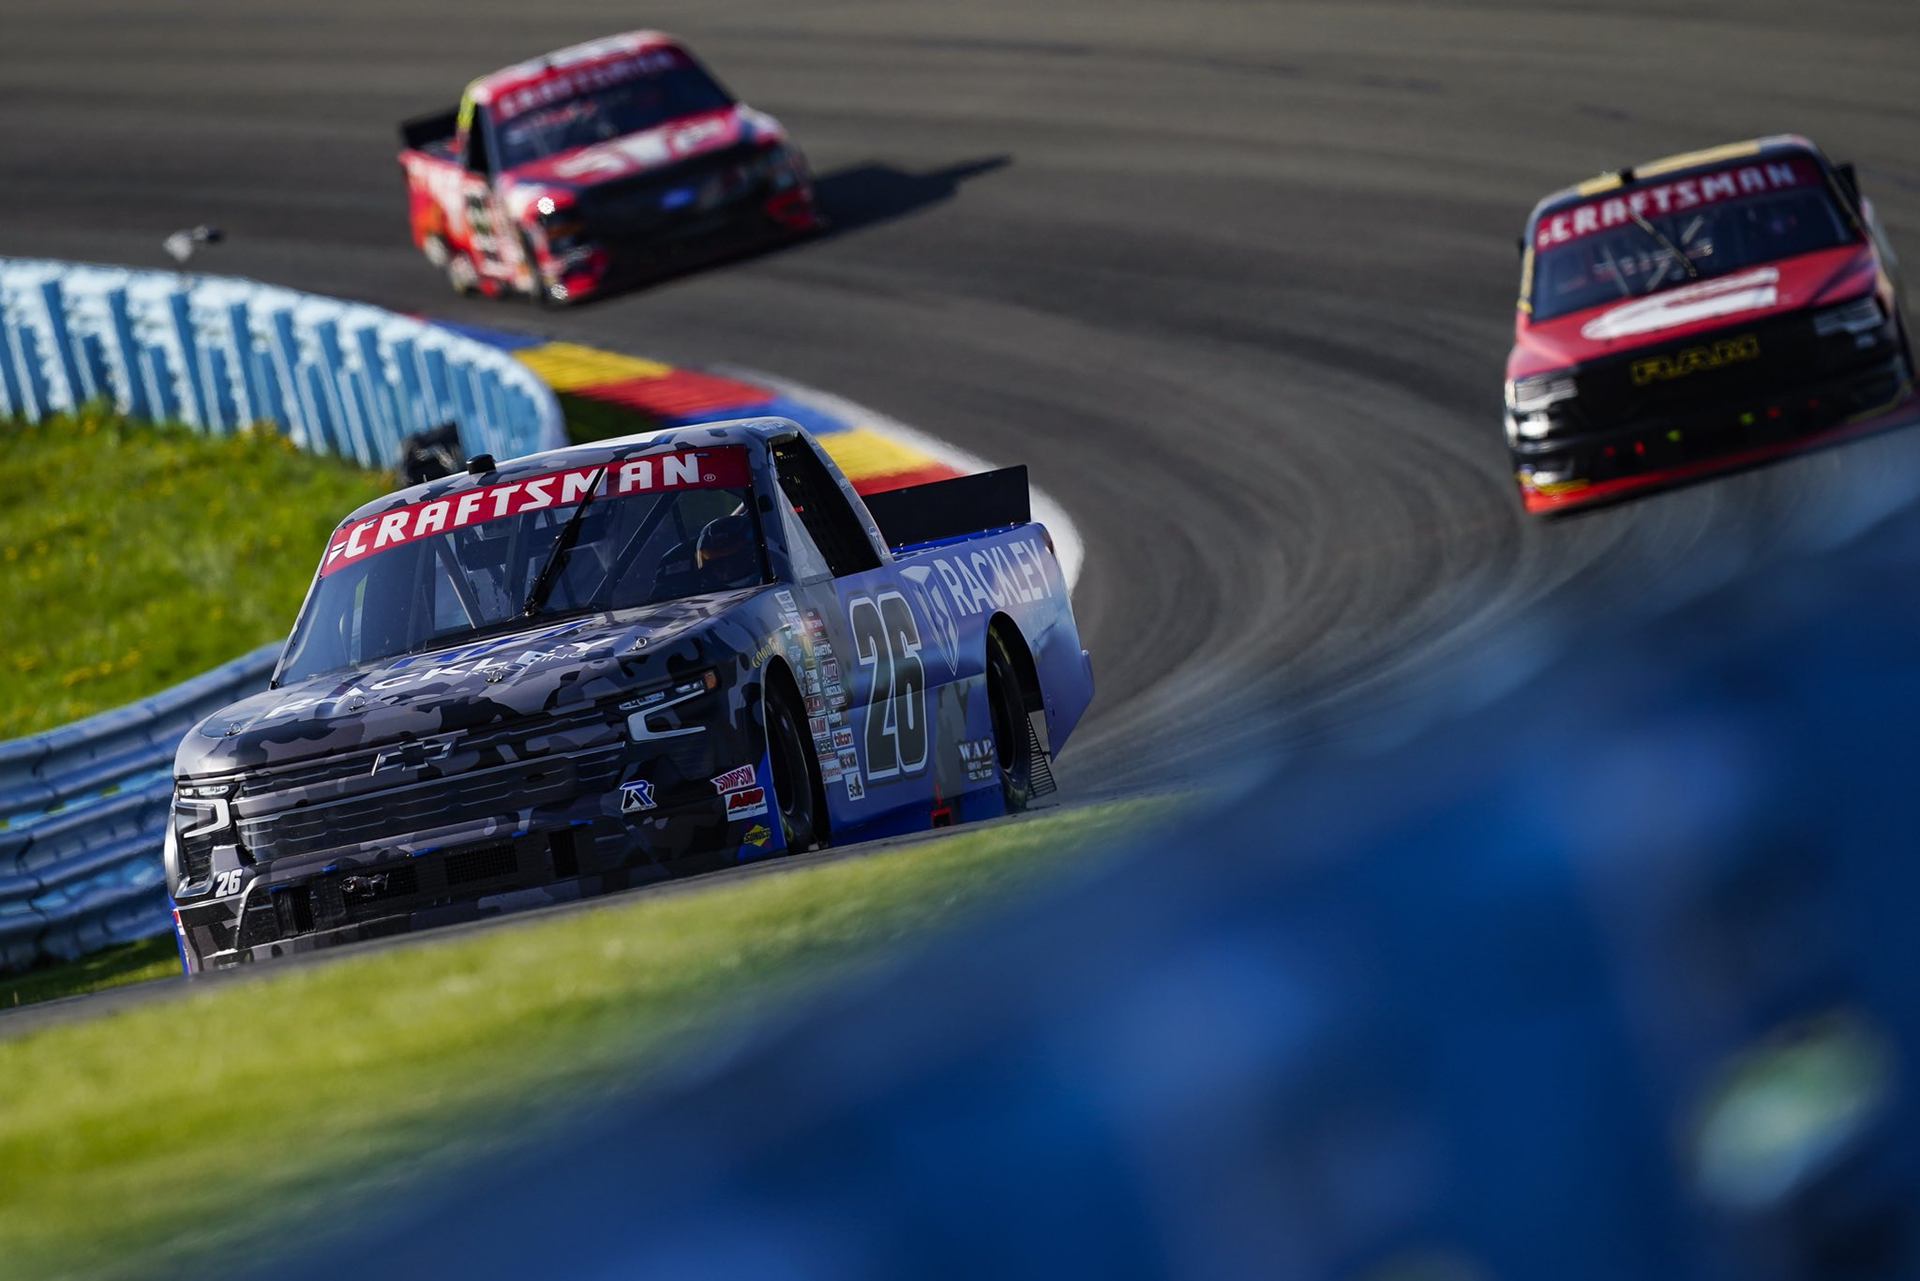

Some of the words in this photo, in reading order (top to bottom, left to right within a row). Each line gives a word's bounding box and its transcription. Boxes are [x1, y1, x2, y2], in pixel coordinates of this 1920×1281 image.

[1549, 162, 1797, 241] CRAFTSMAN
[344, 453, 700, 559] CRAFTSMAN
[933, 538, 1052, 617] RACKLEY
[848, 590, 928, 781] 26
[715, 766, 755, 791] SIMPSON
[215, 869, 243, 898] 26
